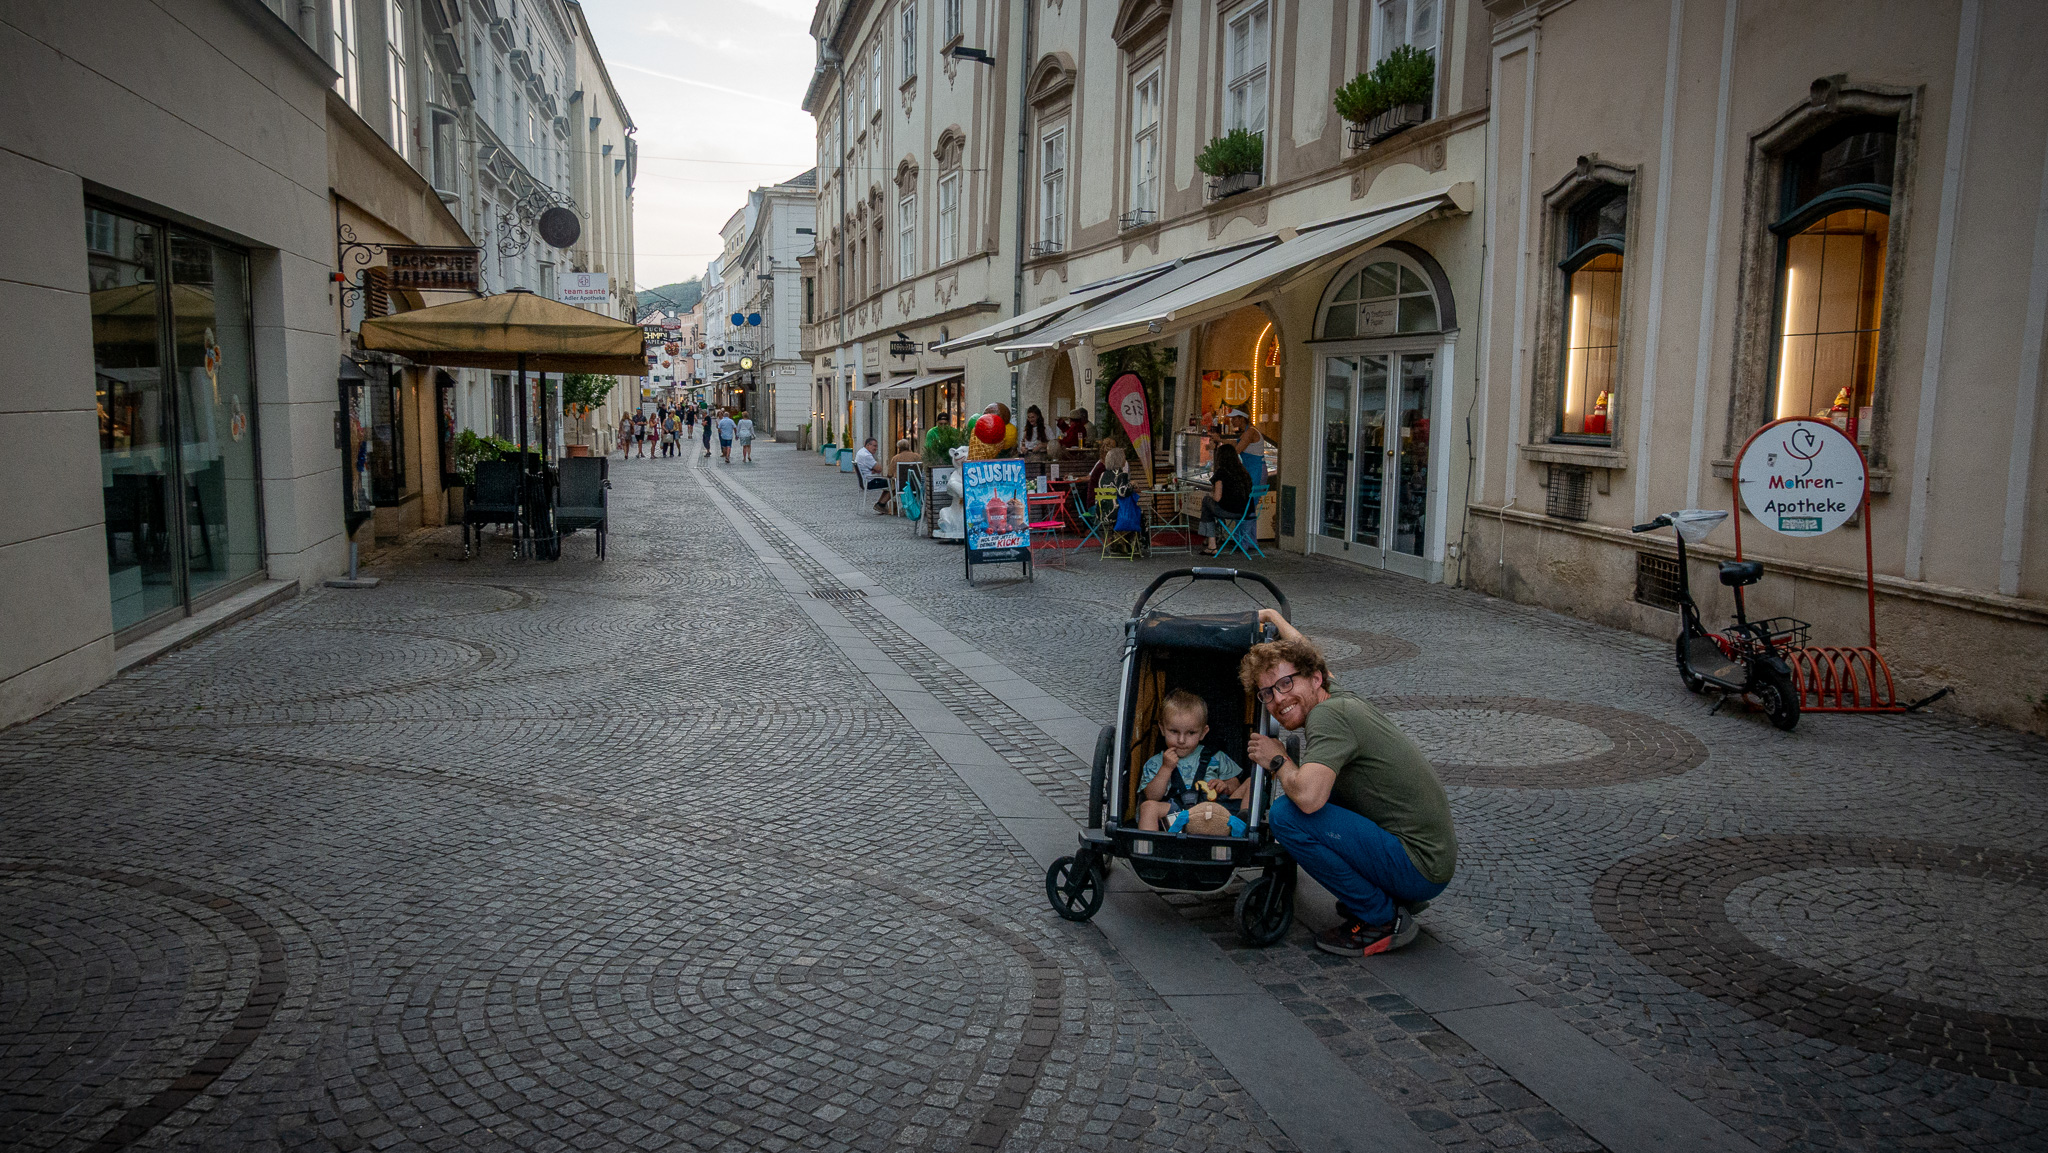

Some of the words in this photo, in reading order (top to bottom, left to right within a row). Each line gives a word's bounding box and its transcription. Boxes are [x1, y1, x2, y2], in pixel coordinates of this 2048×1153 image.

[392, 255, 473, 269] BACKSTUBE
[1225, 379, 1247, 400] EIS
[967, 464, 1022, 487] SLUSHY
[1764, 498, 1846, 517] Apotheke
[997, 537, 1021, 548] KICK!
